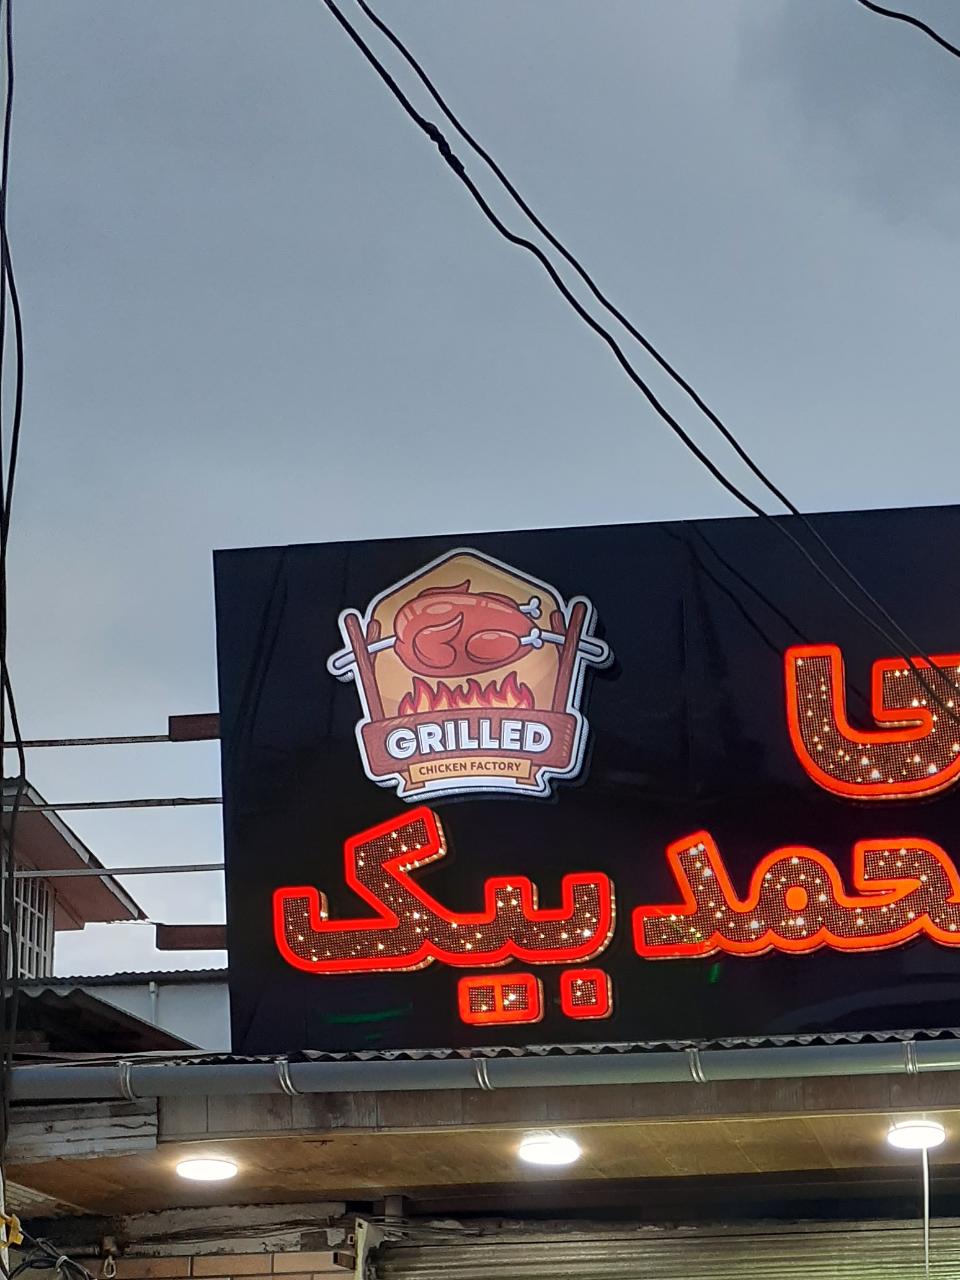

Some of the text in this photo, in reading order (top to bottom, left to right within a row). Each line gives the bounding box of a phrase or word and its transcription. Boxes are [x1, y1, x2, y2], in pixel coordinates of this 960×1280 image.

[386, 718, 552, 759] GRILLED
[418, 760, 522, 776] CHICKEN FACTORY
